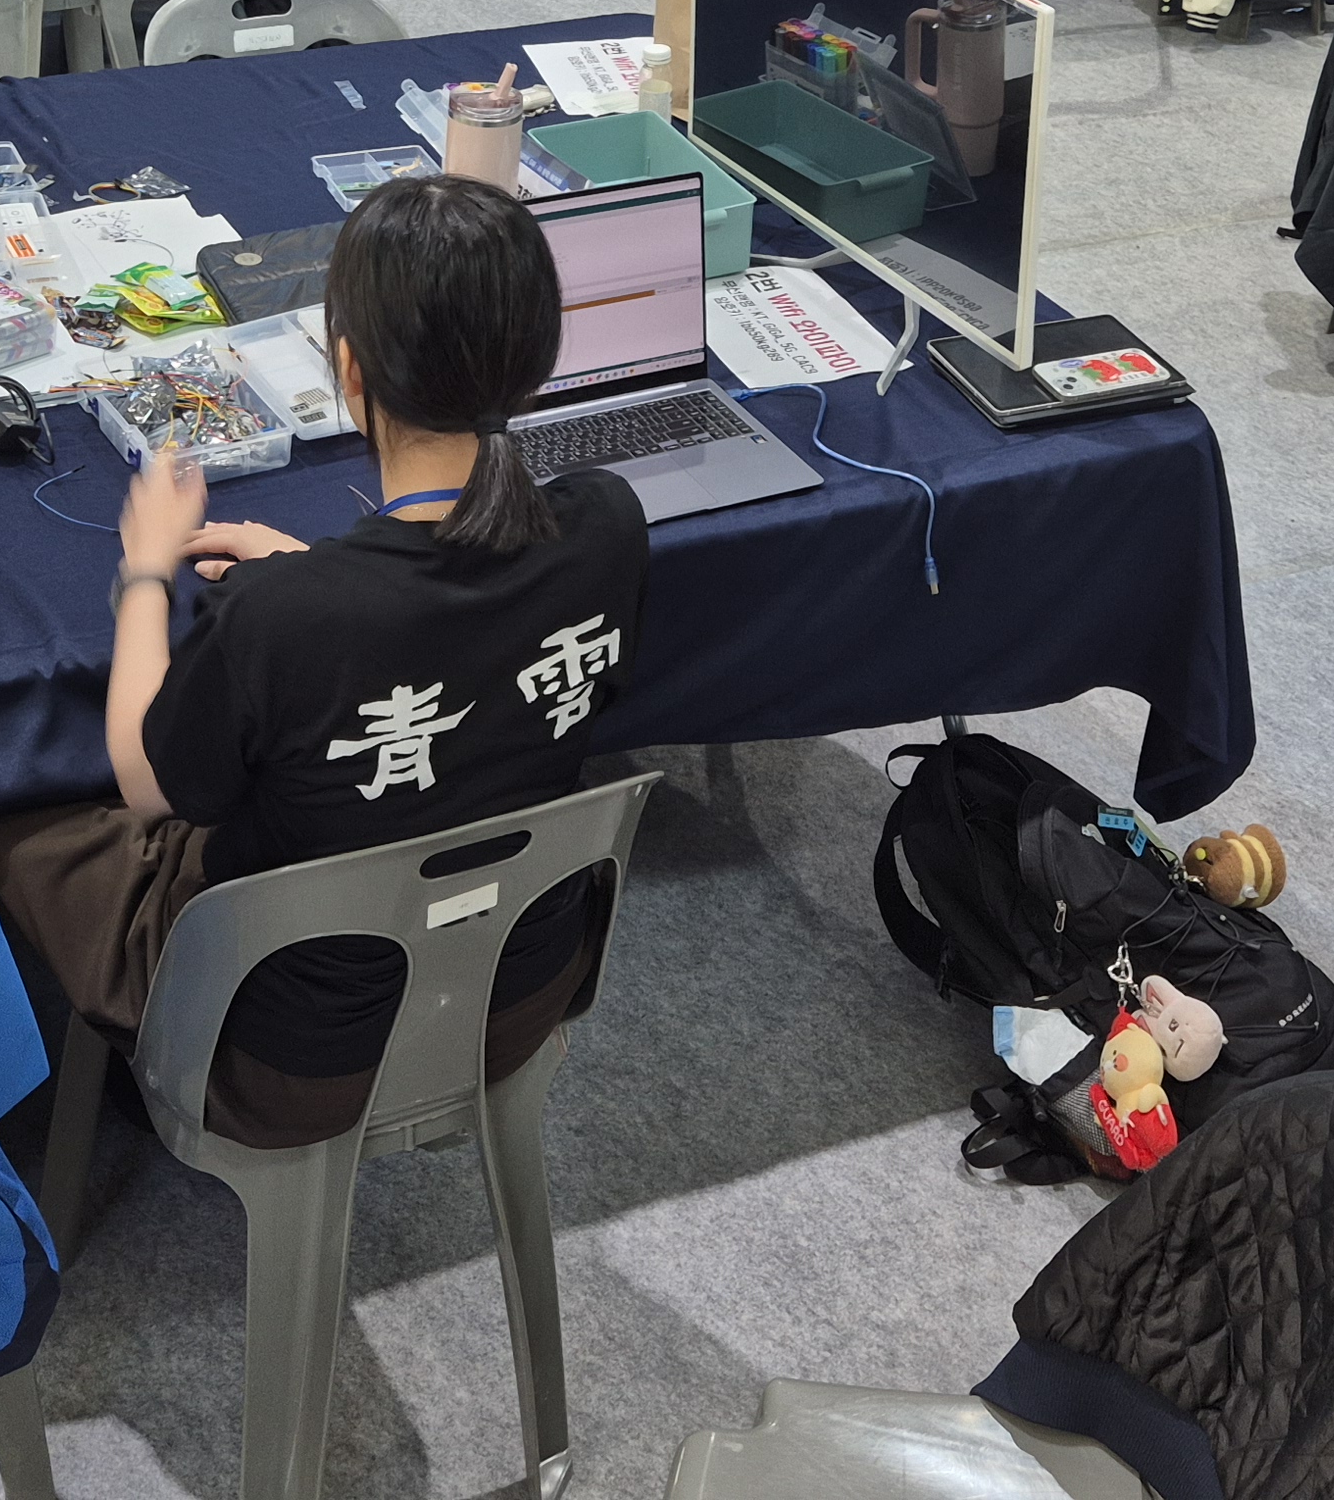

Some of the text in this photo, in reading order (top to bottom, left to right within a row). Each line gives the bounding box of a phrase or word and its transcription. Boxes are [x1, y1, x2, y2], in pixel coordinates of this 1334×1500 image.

[713, 296, 738, 317] 암호키
[721, 280, 754, 310] 무선랜명
[746, 271, 862, 373] 2번 Wifi 와이파이
[1098, 1100, 1124, 1146] GUARD
